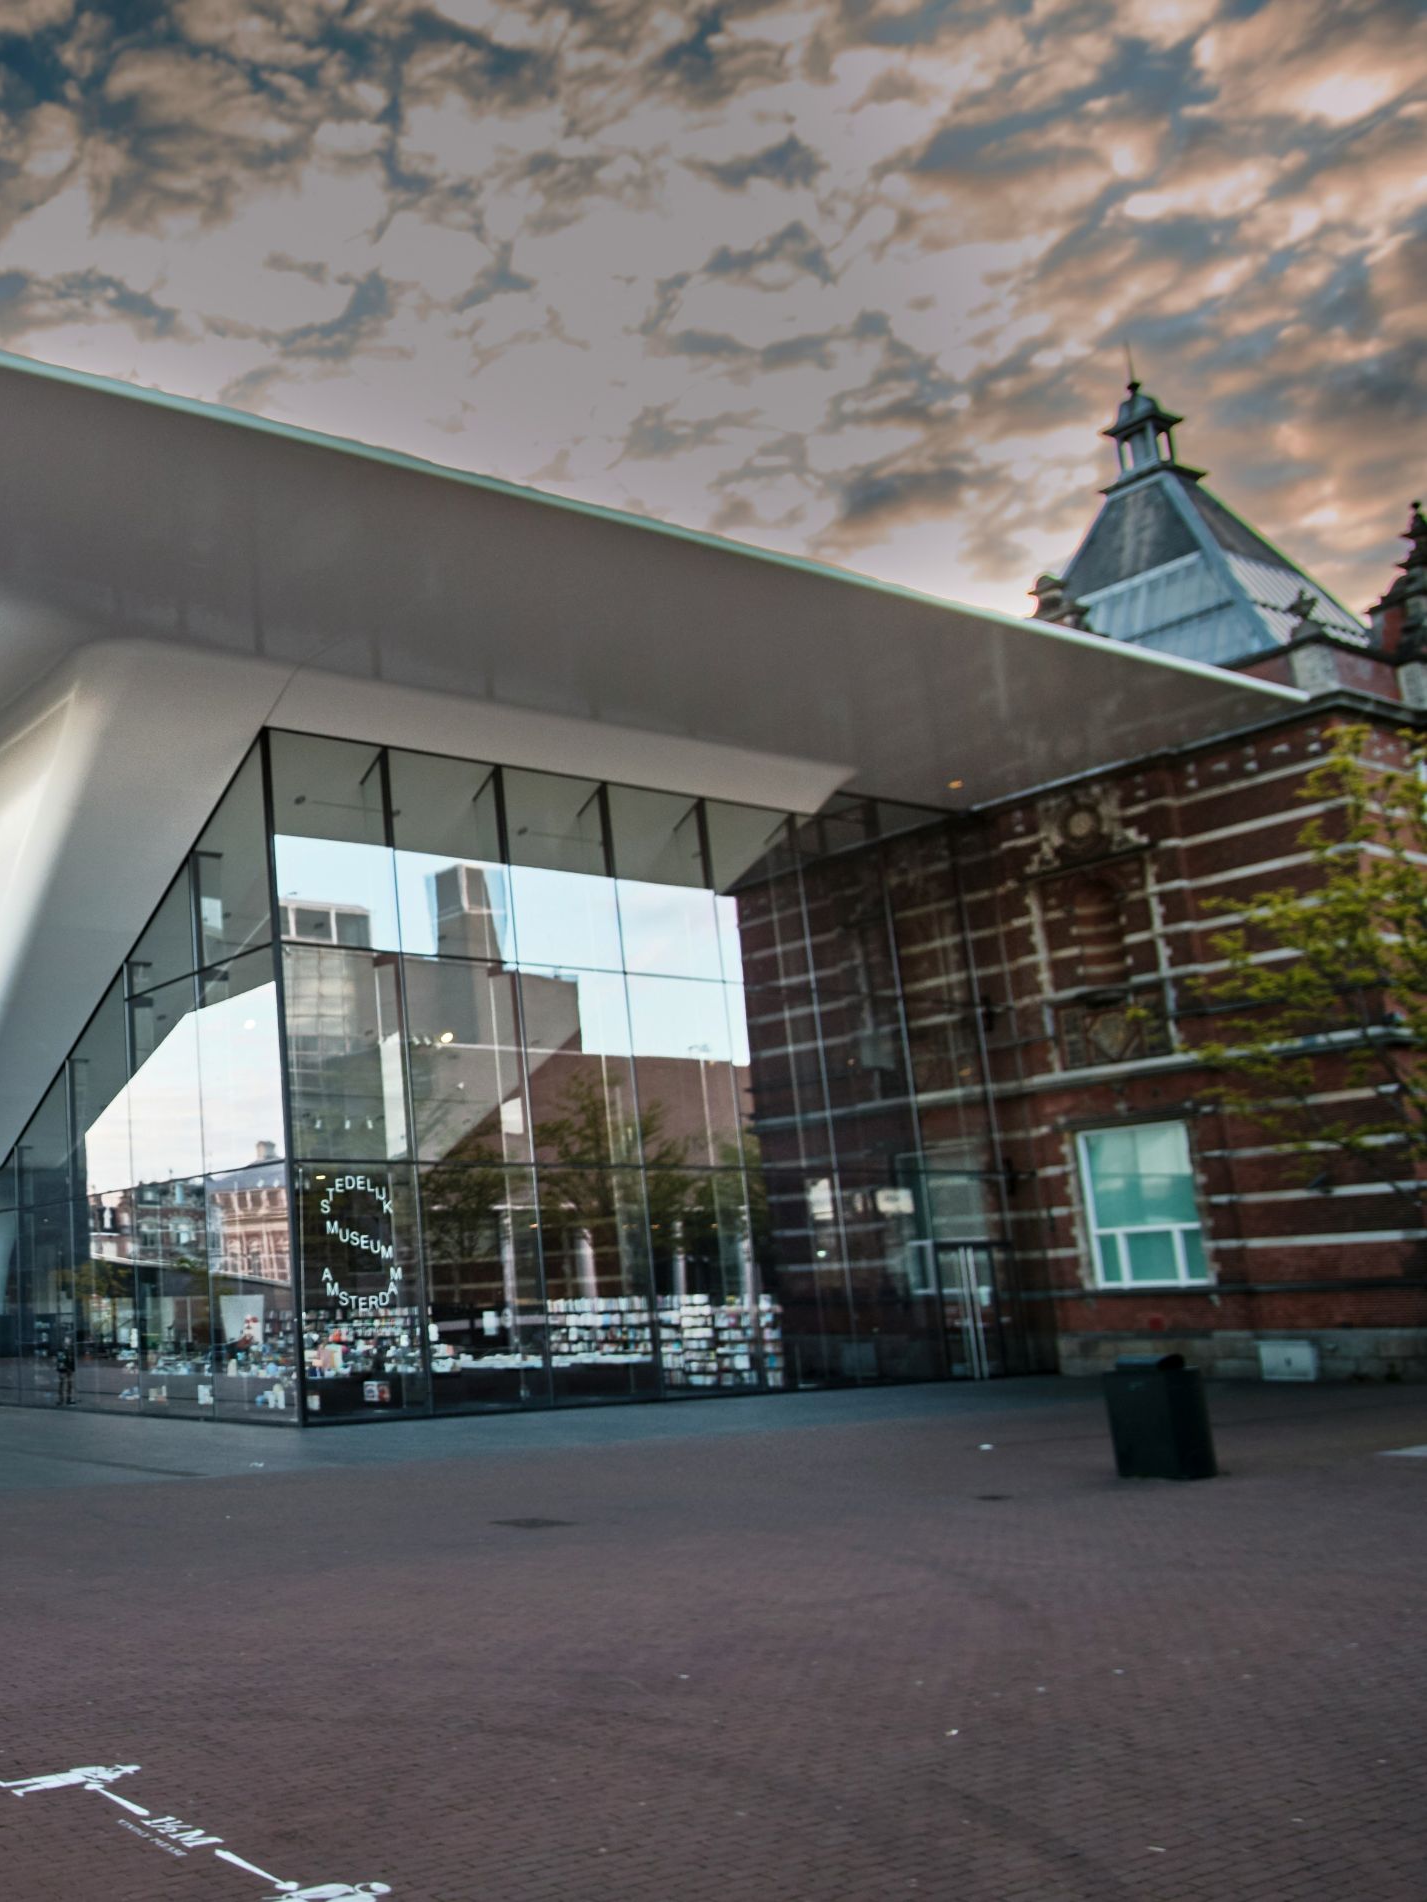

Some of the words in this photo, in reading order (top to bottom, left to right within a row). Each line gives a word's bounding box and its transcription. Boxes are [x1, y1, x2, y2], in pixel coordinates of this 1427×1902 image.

[320, 1175, 394, 1214] STEDELIJK
[325, 1219, 393, 1260] MUSEUM
[321, 1266, 403, 1313] AMSTERDAM
